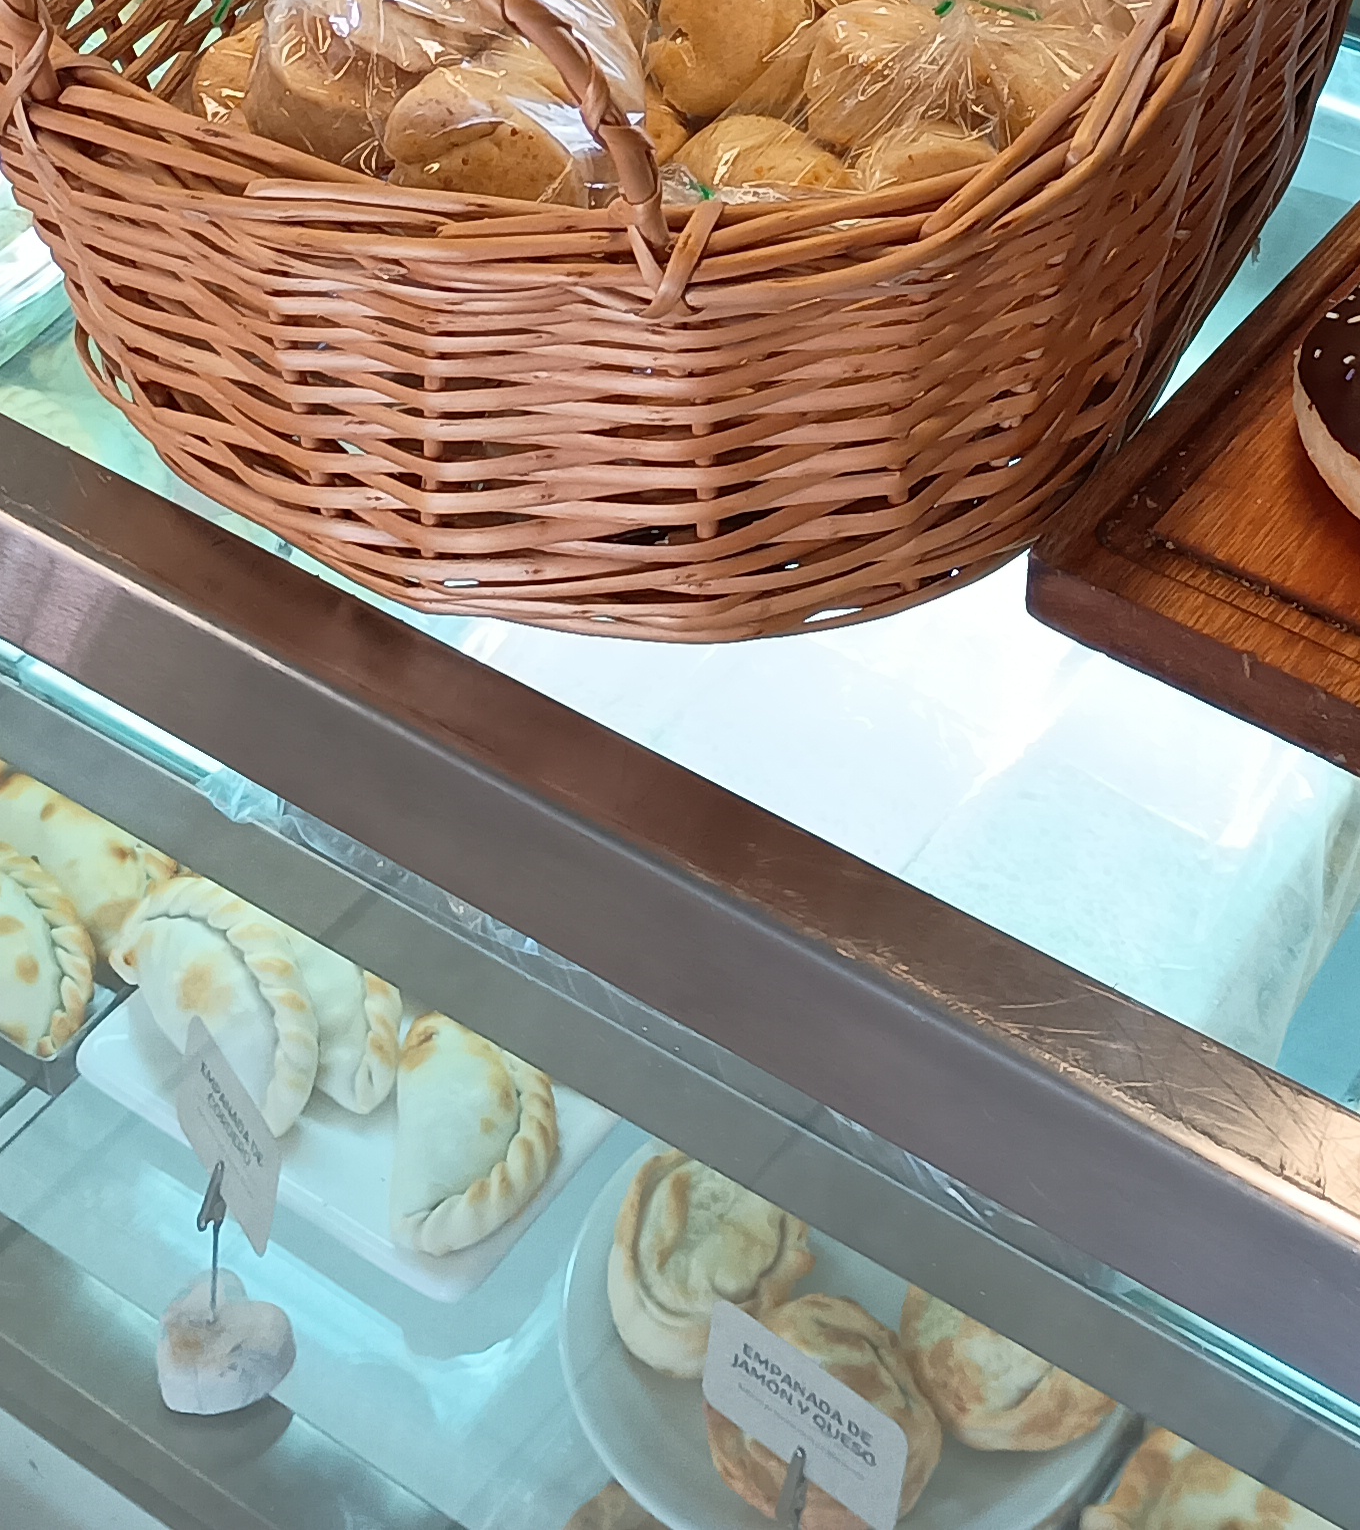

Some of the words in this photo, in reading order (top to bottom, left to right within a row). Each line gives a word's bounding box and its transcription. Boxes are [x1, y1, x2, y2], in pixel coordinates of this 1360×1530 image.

[742, 1342, 843, 1427] EMPANADA
[846, 1418, 874, 1448] DE
[797, 1399, 810, 1415] Y
[811, 1413, 877, 1467] QUESO
